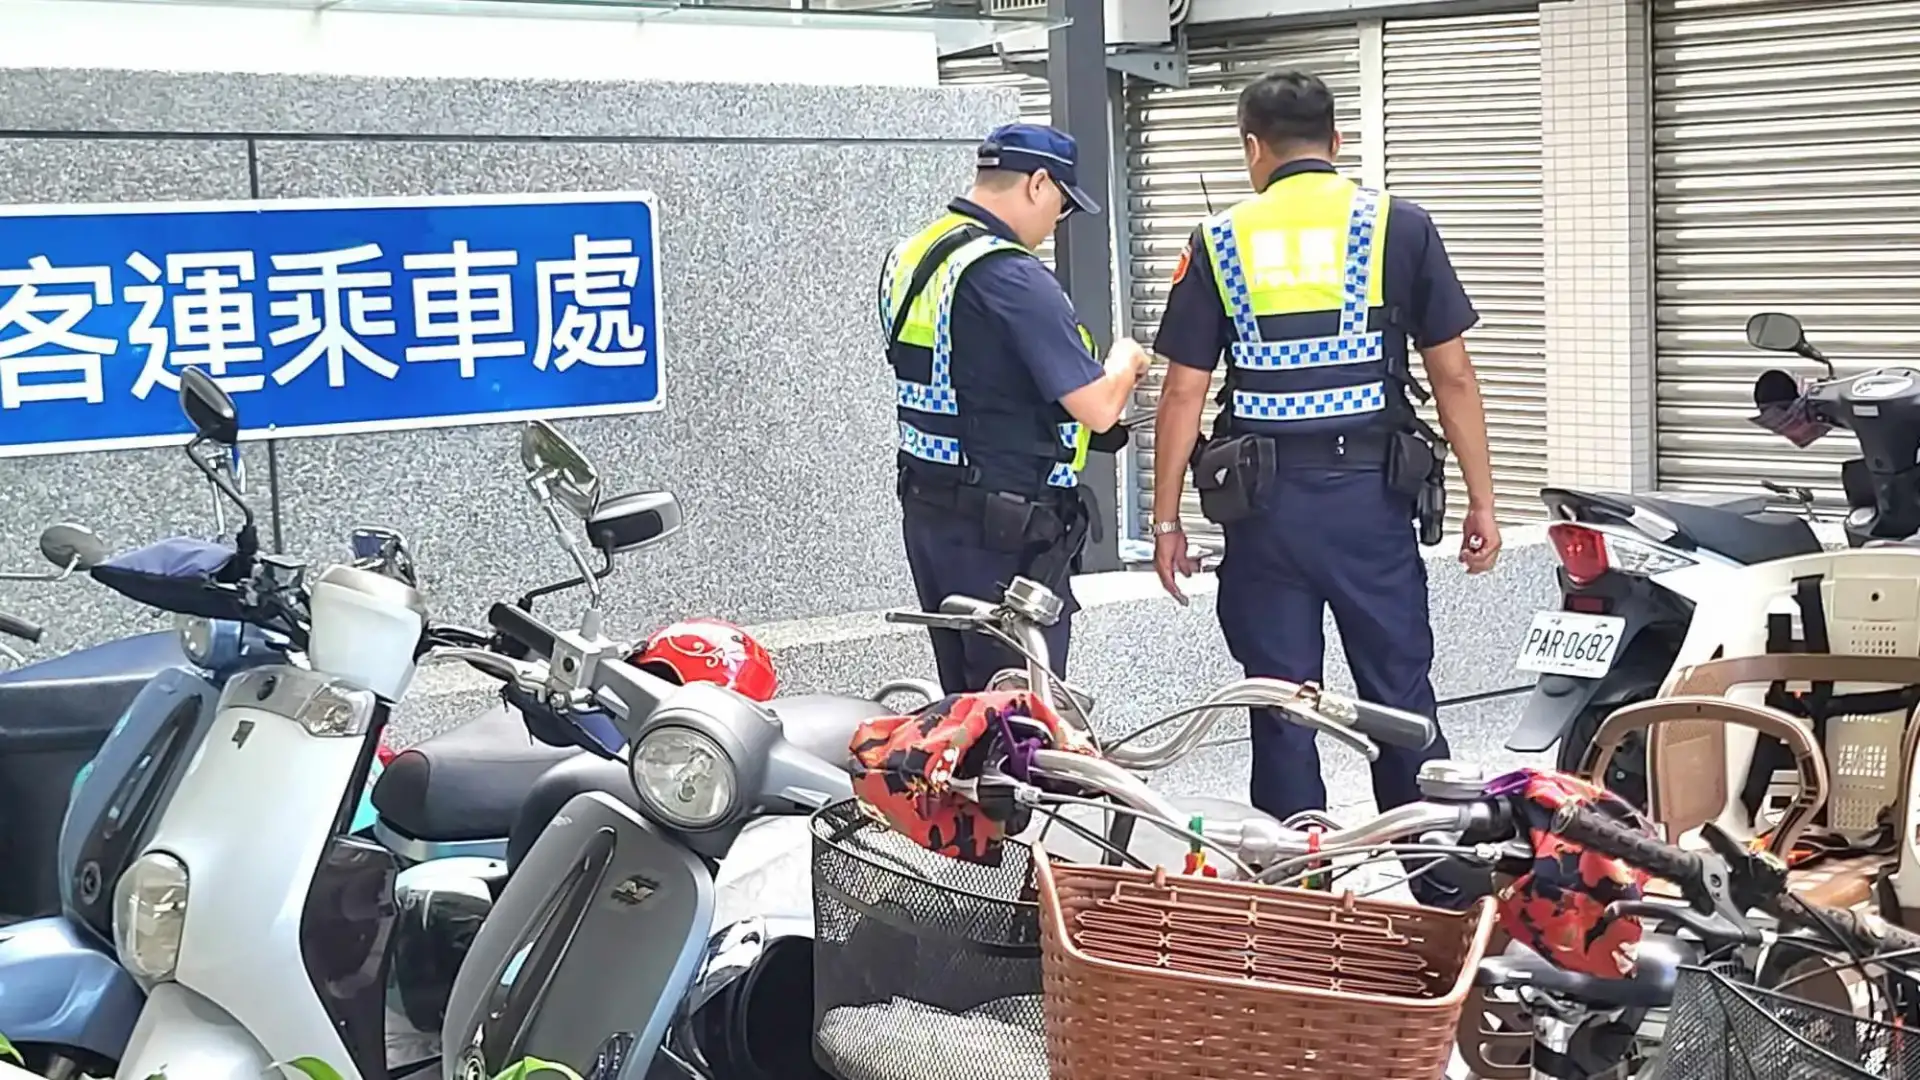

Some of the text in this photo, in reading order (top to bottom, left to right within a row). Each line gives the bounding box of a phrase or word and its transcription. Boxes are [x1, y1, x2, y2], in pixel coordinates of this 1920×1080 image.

[0, 234, 648, 408] 客運乘車處
